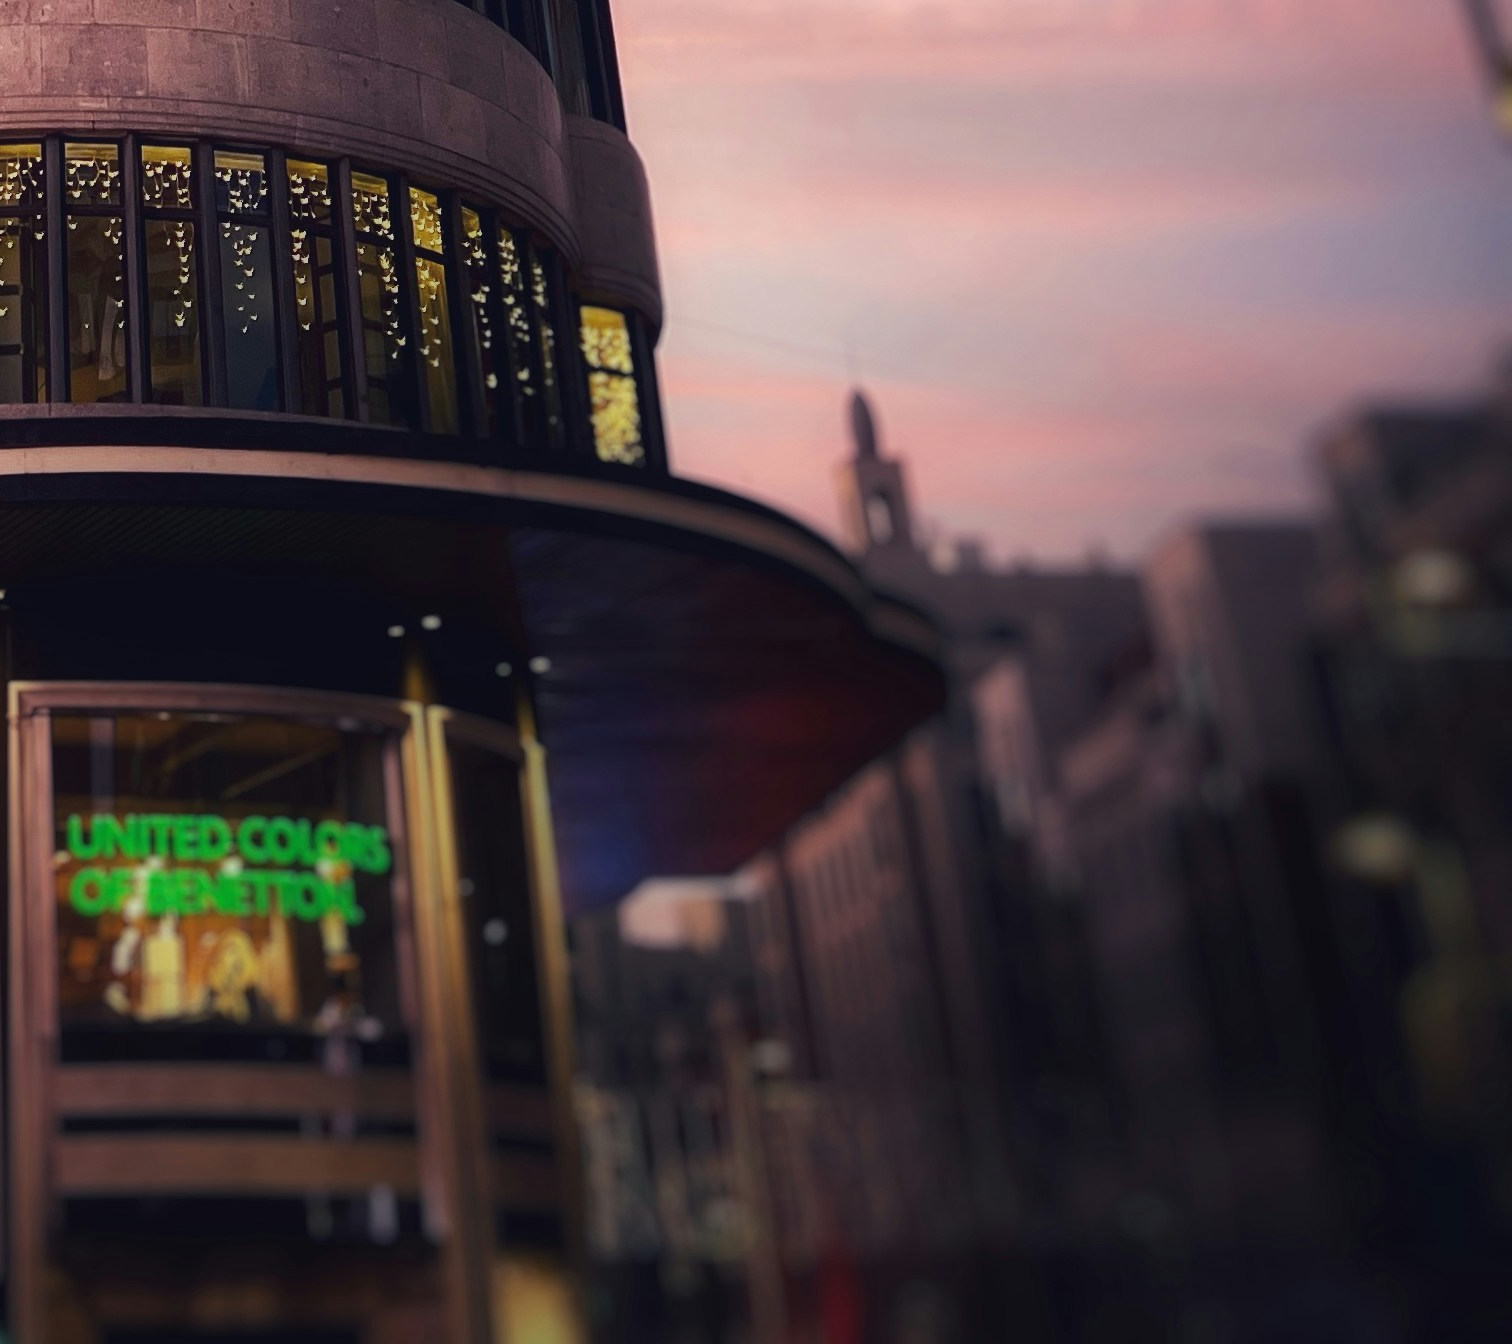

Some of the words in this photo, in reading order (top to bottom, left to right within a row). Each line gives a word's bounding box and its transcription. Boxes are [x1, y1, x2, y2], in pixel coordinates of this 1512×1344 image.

[66, 813, 234, 862] UNITED
[236, 814, 392, 874] COLORS
[69, 867, 133, 917] OF
